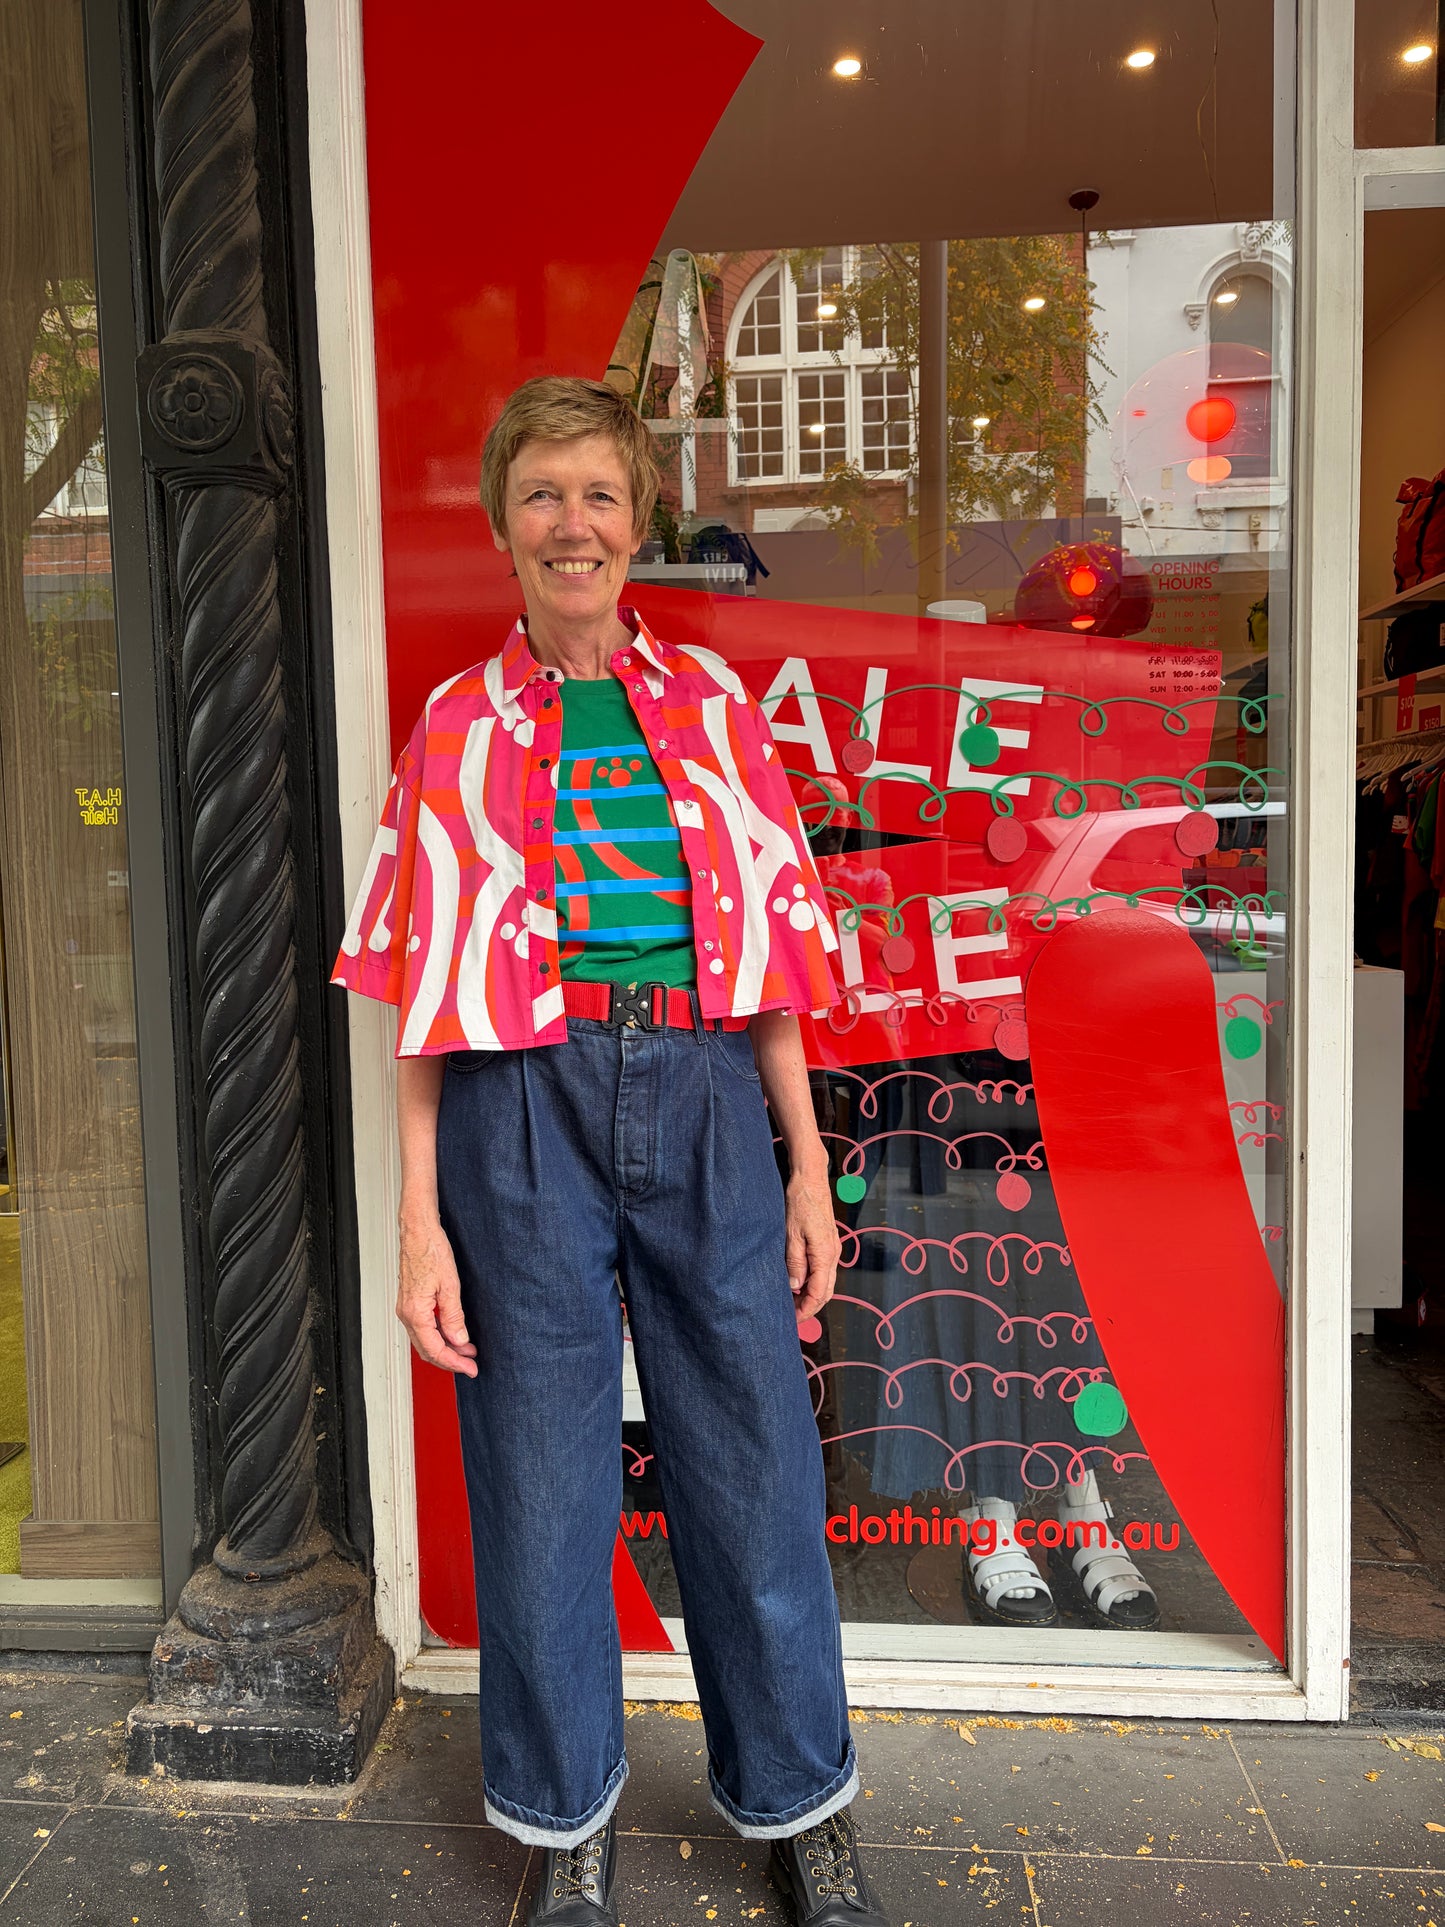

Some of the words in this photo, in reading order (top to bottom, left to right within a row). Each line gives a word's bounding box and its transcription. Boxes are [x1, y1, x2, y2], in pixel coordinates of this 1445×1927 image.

[1151, 561, 1219, 575] OPENING
[1159, 577, 1212, 590] HOURS
[1149, 671, 1167, 679] SAT
[1200, 684, 1218, 692] 4:00
[760, 657, 1044, 796] ALE
[1424, 717, 1440, 730] $150
[811, 887, 1022, 1019] LE
[825, 1504, 1180, 1556] clothing.com.au
